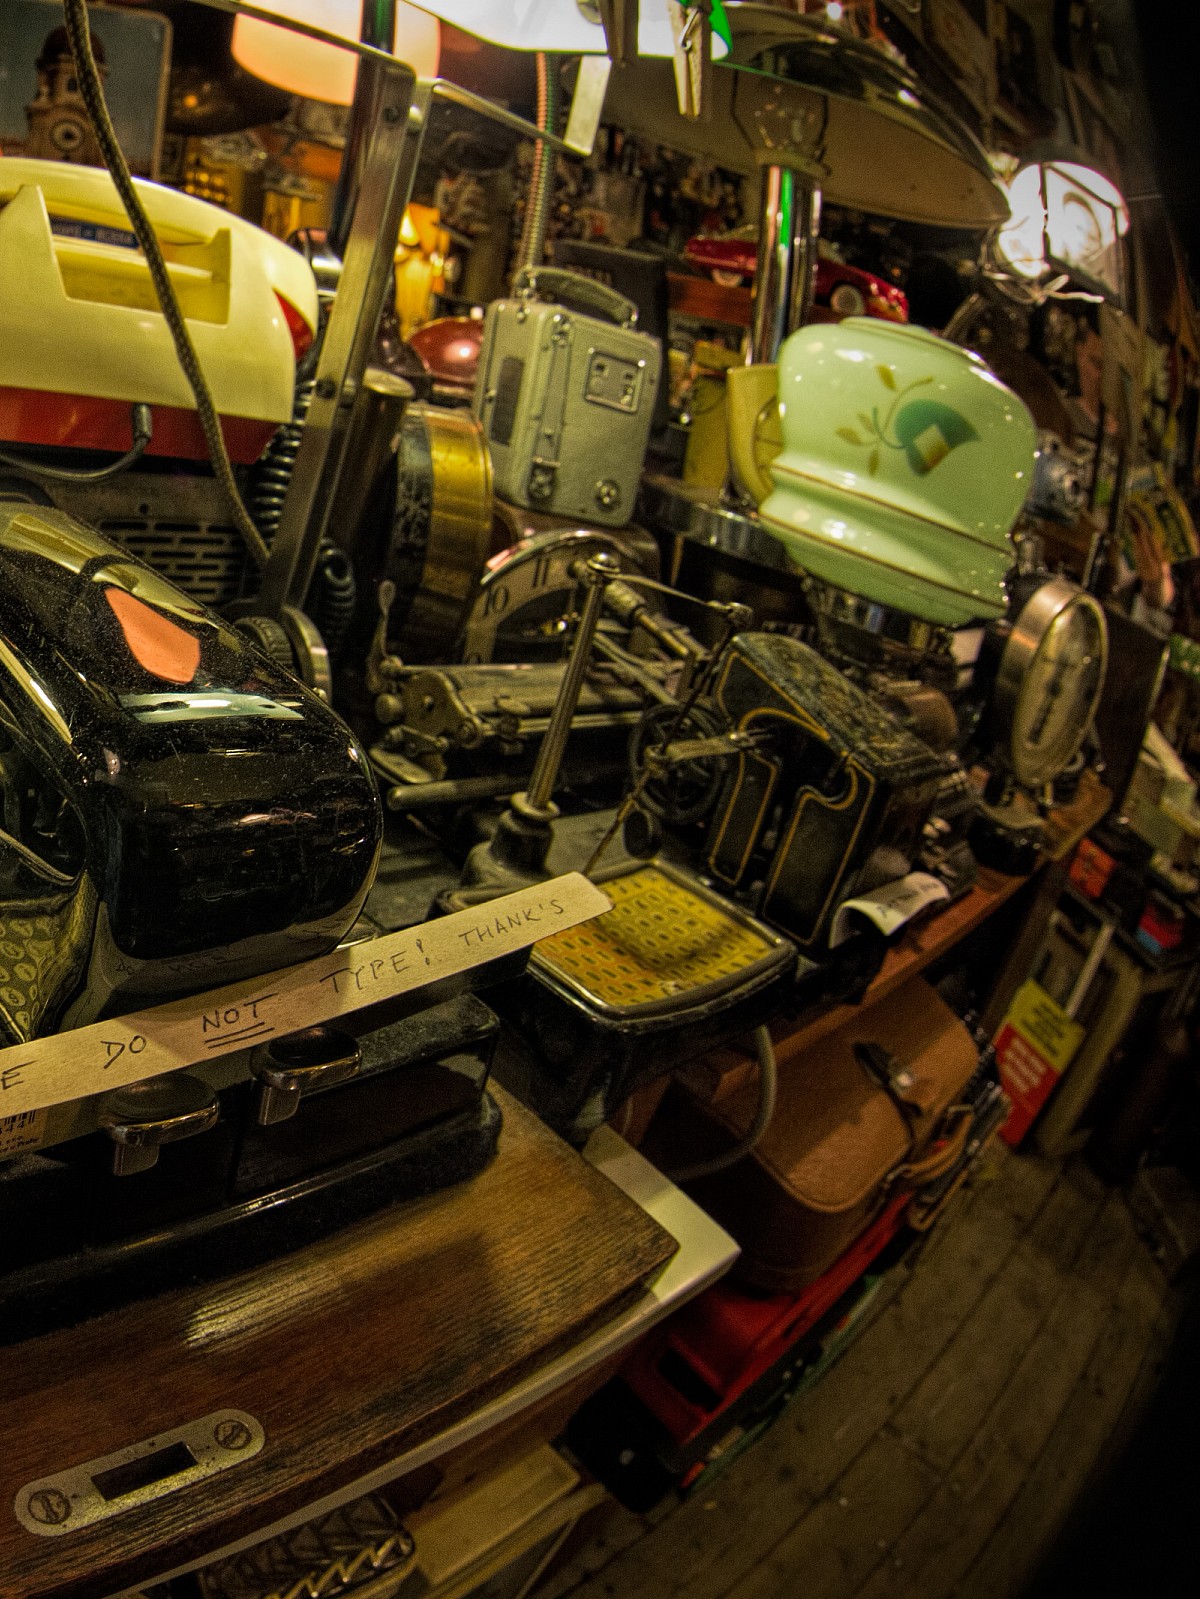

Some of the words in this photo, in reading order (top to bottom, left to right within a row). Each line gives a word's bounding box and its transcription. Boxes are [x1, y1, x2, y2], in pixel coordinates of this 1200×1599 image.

[531, 558, 550, 588] 11
[484, 585, 509, 617] 10
[101, 1035, 147, 1069] DO
[202, 993, 280, 1034] NOT
[319, 938, 435, 995] TYPE!
[458, 898, 565, 949] THANK'S
